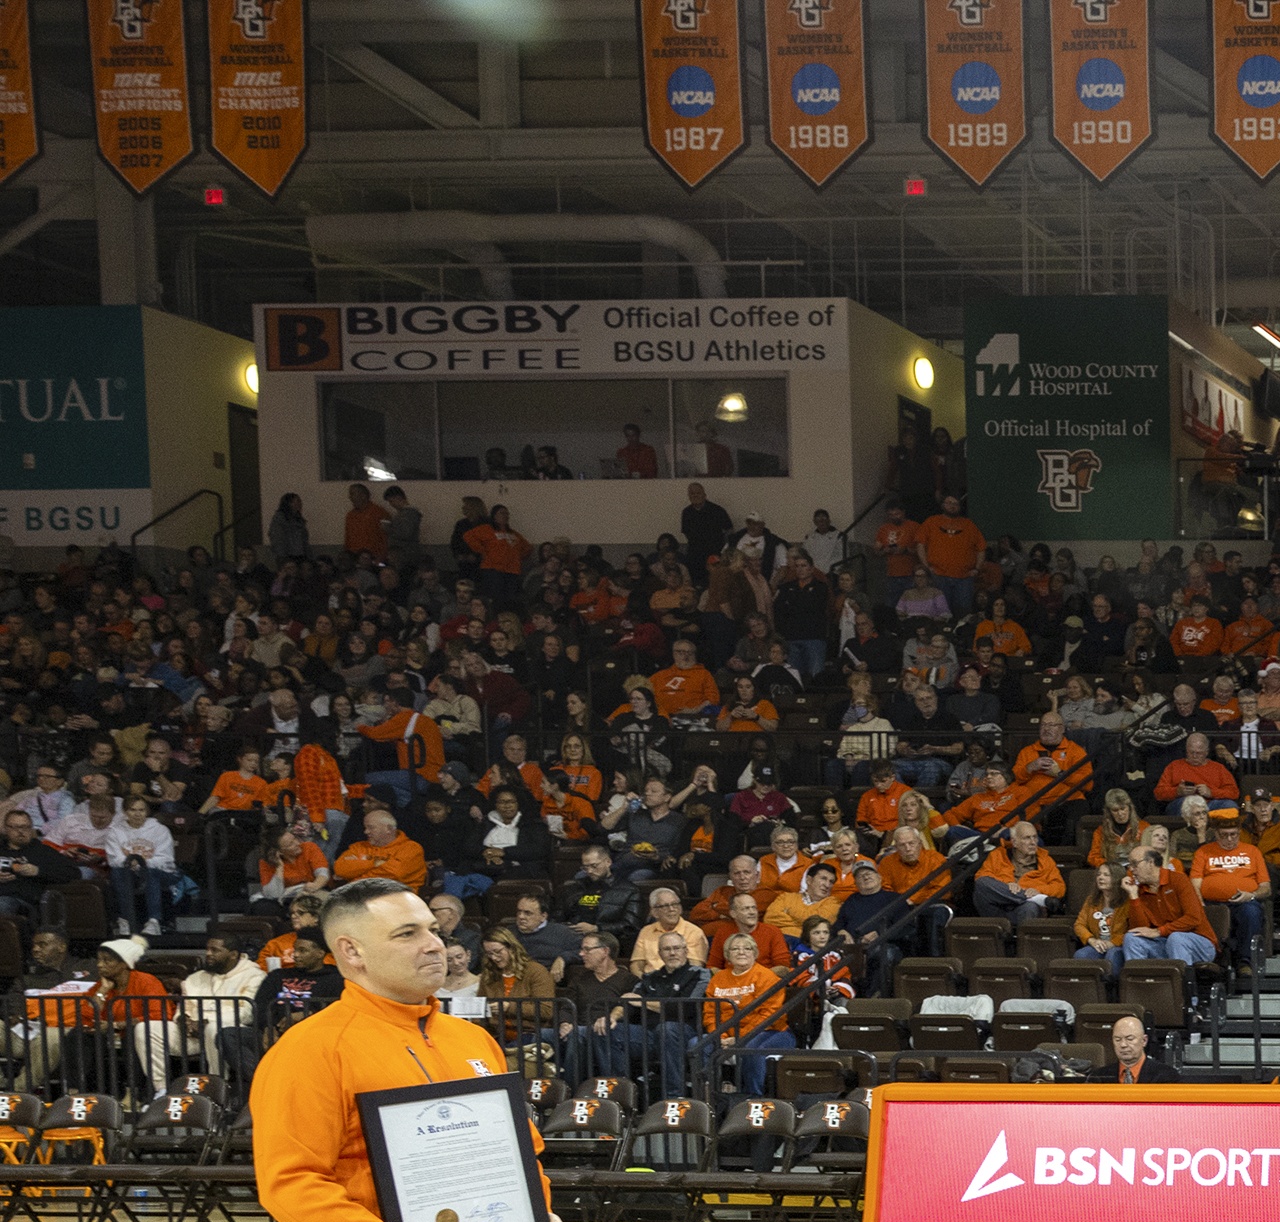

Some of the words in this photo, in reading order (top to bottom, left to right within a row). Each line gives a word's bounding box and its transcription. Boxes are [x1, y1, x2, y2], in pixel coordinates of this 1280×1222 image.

[662, 35, 718, 47] WOMEN'S
[786, 33, 843, 45] WOMEN'S
[1061, 39, 1136, 51] BASKETBALL
[652, 47, 728, 59] BASKETBALL
[777, 44, 853, 56] BASKETBALL
[937, 42, 1012, 54] BASKETBALL
[113, 73, 162, 87] MAC
[233, 72, 282, 86] MAC
[100, 88, 182, 98] TOURNAMENT
[218, 87, 299, 97] TOURNAMENT
[671, 90, 714, 106] NCAA
[796, 87, 840, 103] NCAA
[956, 87, 1000, 102] NCAA
[1080, 83, 1124, 99] NCAA
[100, 100, 184, 113] CHAMPIONS
[218, 97, 300, 110] CHAMPIONS
[118, 118, 161, 130] 2005
[243, 117, 281, 130] 2010
[664, 127, 724, 152] 1987
[788, 124, 849, 149] 1988
[948, 122, 1008, 147] 1989
[1072, 120, 1132, 144] 1990
[119, 136, 162, 149] 2006
[247, 135, 280, 148] 2011
[120, 155, 163, 168] 2007
[348, 305, 581, 334] BIGGBY
[604, 306, 699, 328] Official
[710, 305, 799, 327] Coffee
[808, 304, 834, 326] of
[278, 314, 330, 366] B
[614, 341, 695, 362] BGSU
[704, 340, 825, 361] Athletics
[351, 348, 581, 371] COFFEE
[1029, 363, 1082, 379] WOOD
[1086, 363, 1158, 379] COUNTY
[1030, 381, 1112, 396] HOSPITAL
[984, 420, 1049, 436] Official
[1056, 420, 1127, 440] Hospital
[1132, 419, 1152, 436] of
[25, 506, 120, 531] BGSU
[1209, 856, 1251, 866] FALCONS
[417, 1127, 425, 1135] A
[427, 1120, 479, 1134] Resolution
[1034, 1148, 1135, 1186] BSN
